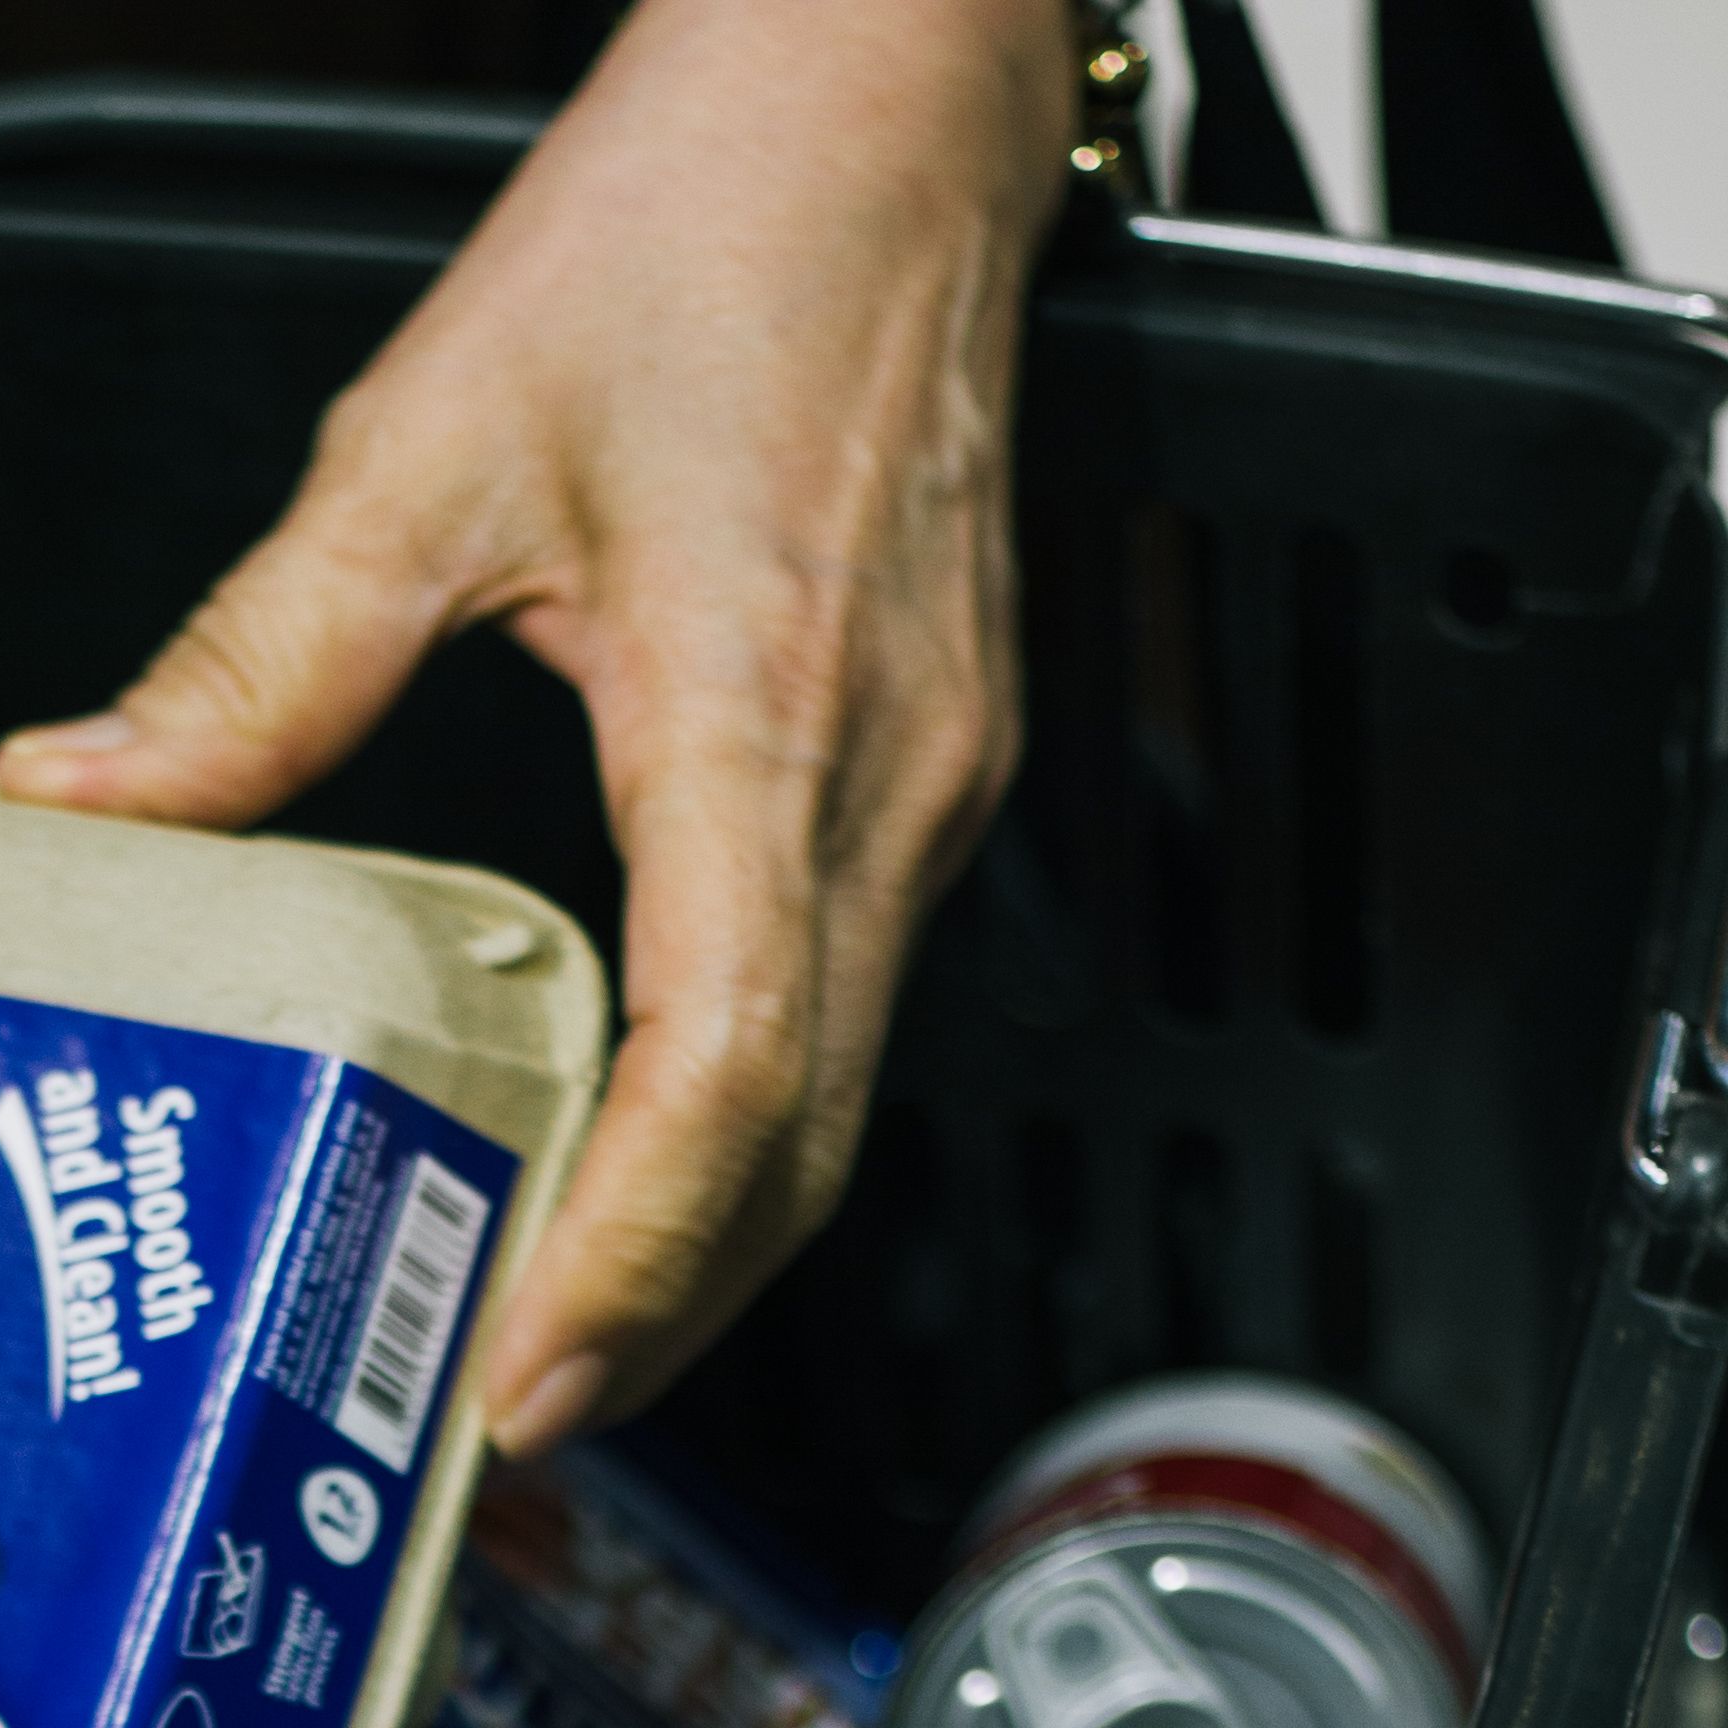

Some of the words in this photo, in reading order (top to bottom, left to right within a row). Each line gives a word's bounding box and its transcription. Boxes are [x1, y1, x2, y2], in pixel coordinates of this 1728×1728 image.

[36, 1068, 122, 1194] and
[120, 1085, 215, 1340] Smooth
[66, 1196, 141, 1403] Clean!
